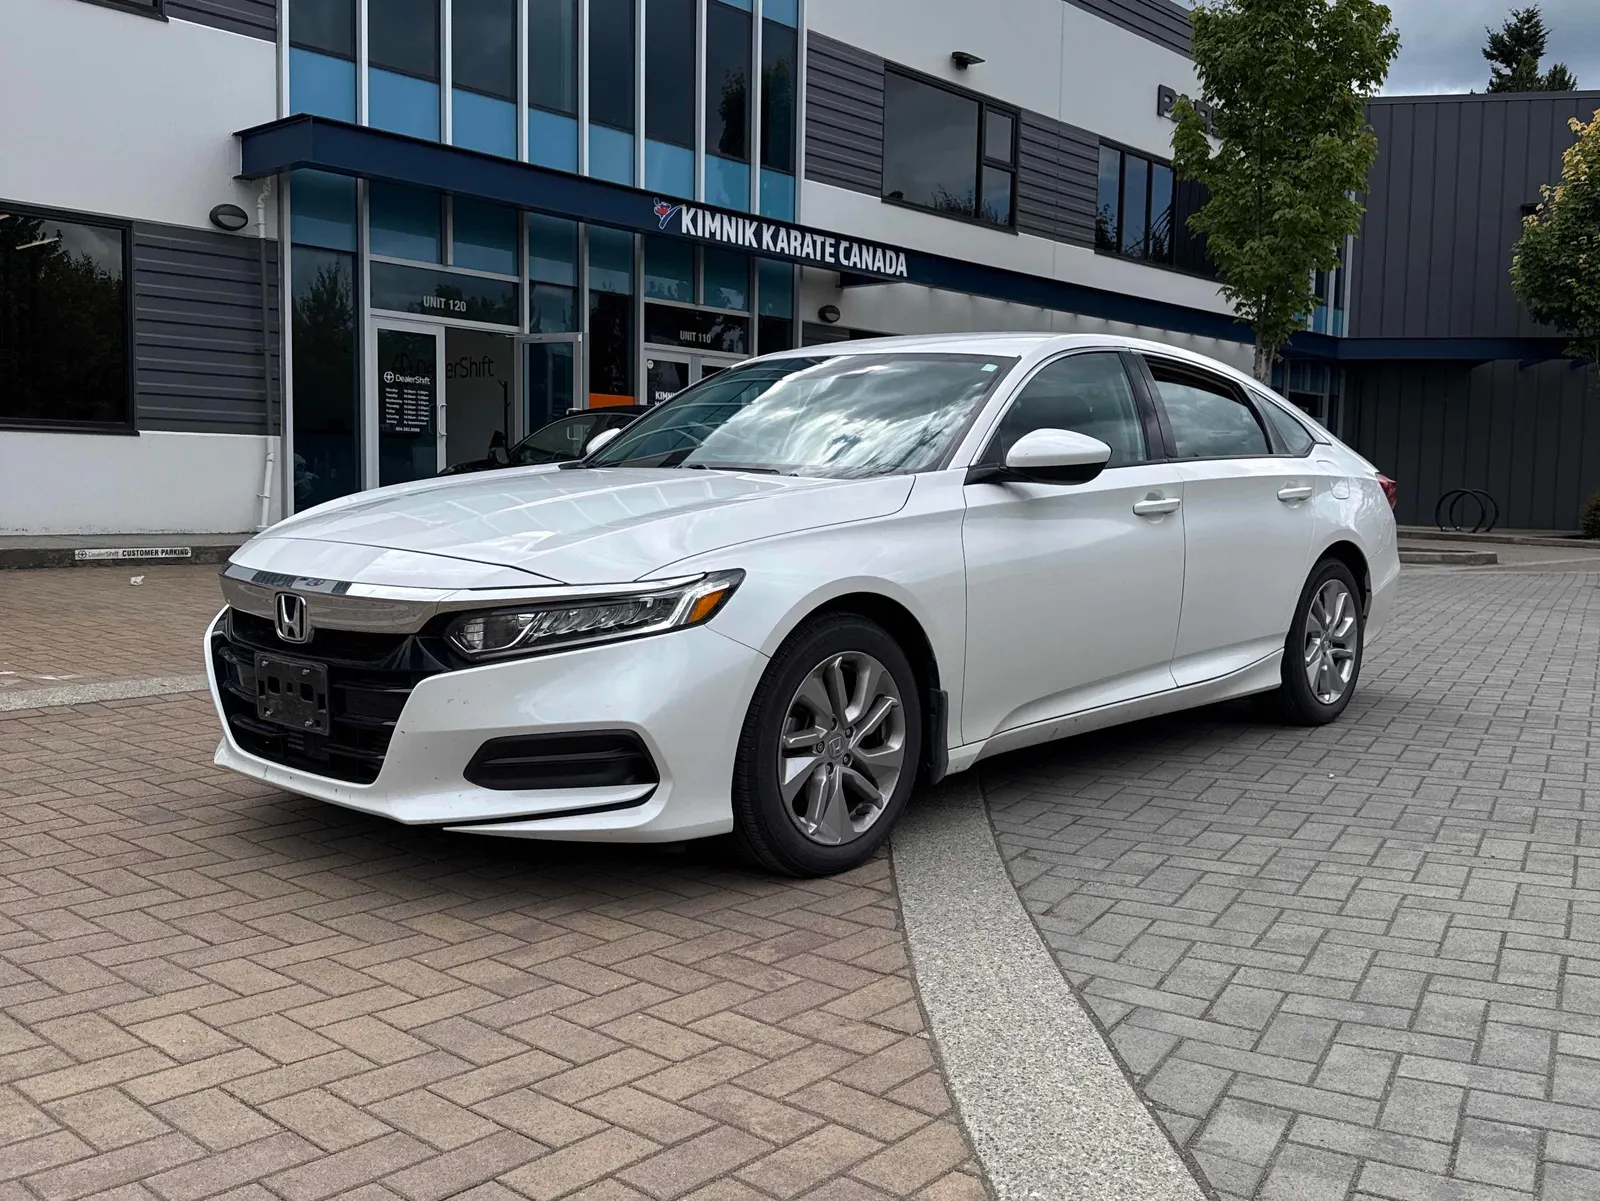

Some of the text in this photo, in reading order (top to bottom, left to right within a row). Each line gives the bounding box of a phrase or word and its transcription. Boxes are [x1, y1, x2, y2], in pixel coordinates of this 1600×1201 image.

[681, 206, 908, 277] KIMNIK KARATE CANADA
[423, 295, 467, 312] UNIT 120
[680, 330, 711, 343] UNIT 110
[395, 374, 430, 384] DealerShift
[122, 549, 159, 557] CUSTOMER
[161, 548, 189, 556] PARKING
